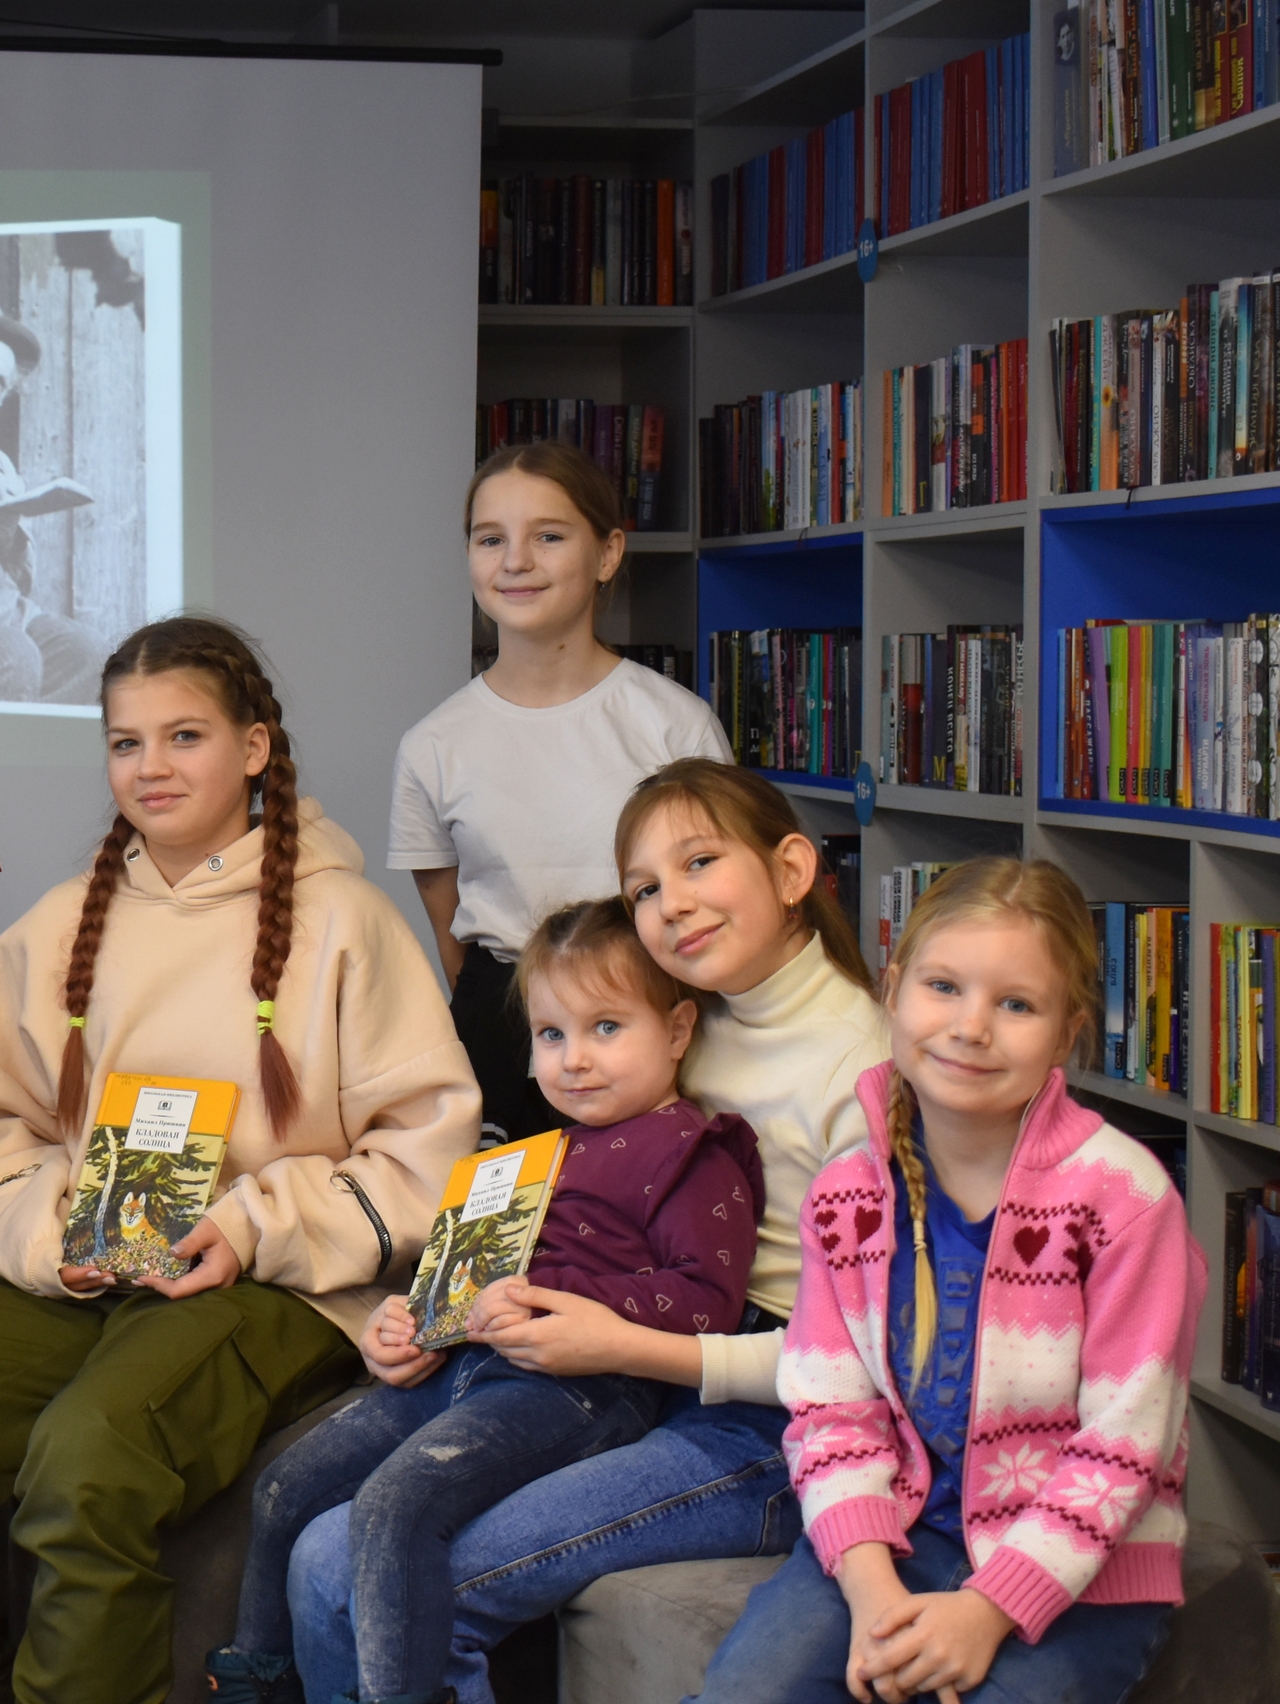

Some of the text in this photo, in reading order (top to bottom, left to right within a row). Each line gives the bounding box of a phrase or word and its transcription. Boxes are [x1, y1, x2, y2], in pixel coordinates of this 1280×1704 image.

[859, 239, 874, 259] 16+
[1152, 404, 1160, 448] ДЖИО
[1202, 646, 1210, 722] МАЛЕНЬКАЯ ЛОЖЬ
[1201, 739, 1210, 790] МОРИАРТИ
[856, 781, 871, 800] 16+
[135, 1128, 180, 1139] КЛАДОВАЯ
[138, 1138, 171, 1148] СОЛНЦА
[469, 1192, 507, 1208] КЛАДОВАЯ
[471, 1203, 499, 1216] СОЛНЦА
